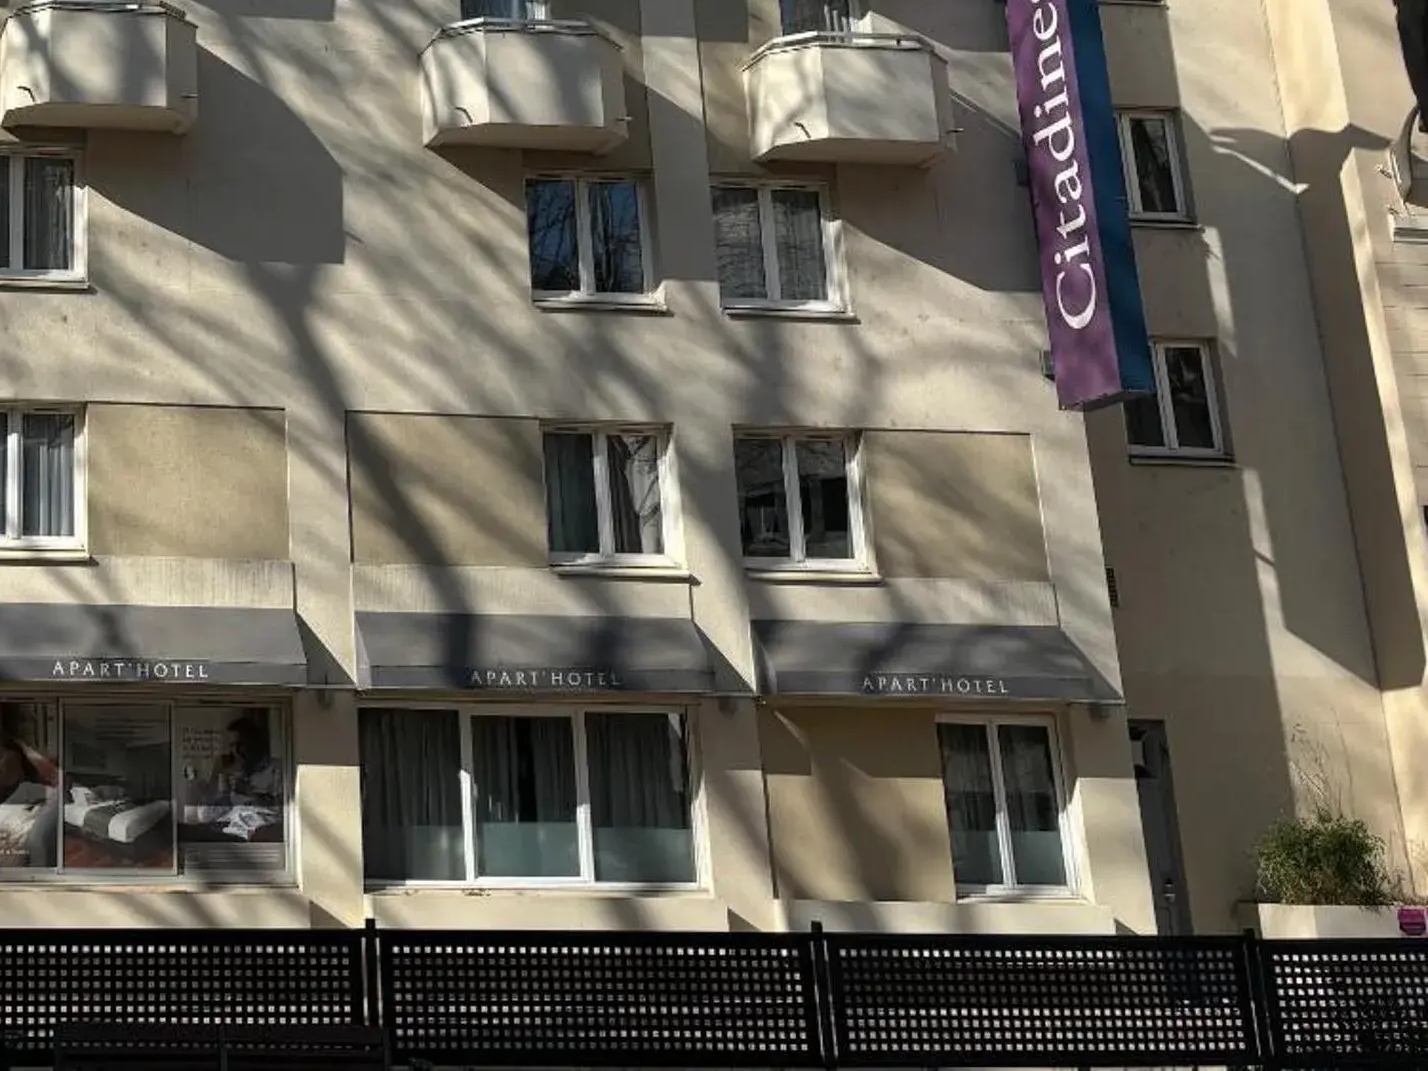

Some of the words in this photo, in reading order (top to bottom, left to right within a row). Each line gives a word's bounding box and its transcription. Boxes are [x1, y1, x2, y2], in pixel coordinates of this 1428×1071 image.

[52, 661, 208, 678] APART'HOTEL
[470, 669, 621, 686] APART'HOTEL
[862, 675, 1009, 693] APART'HOTEL
